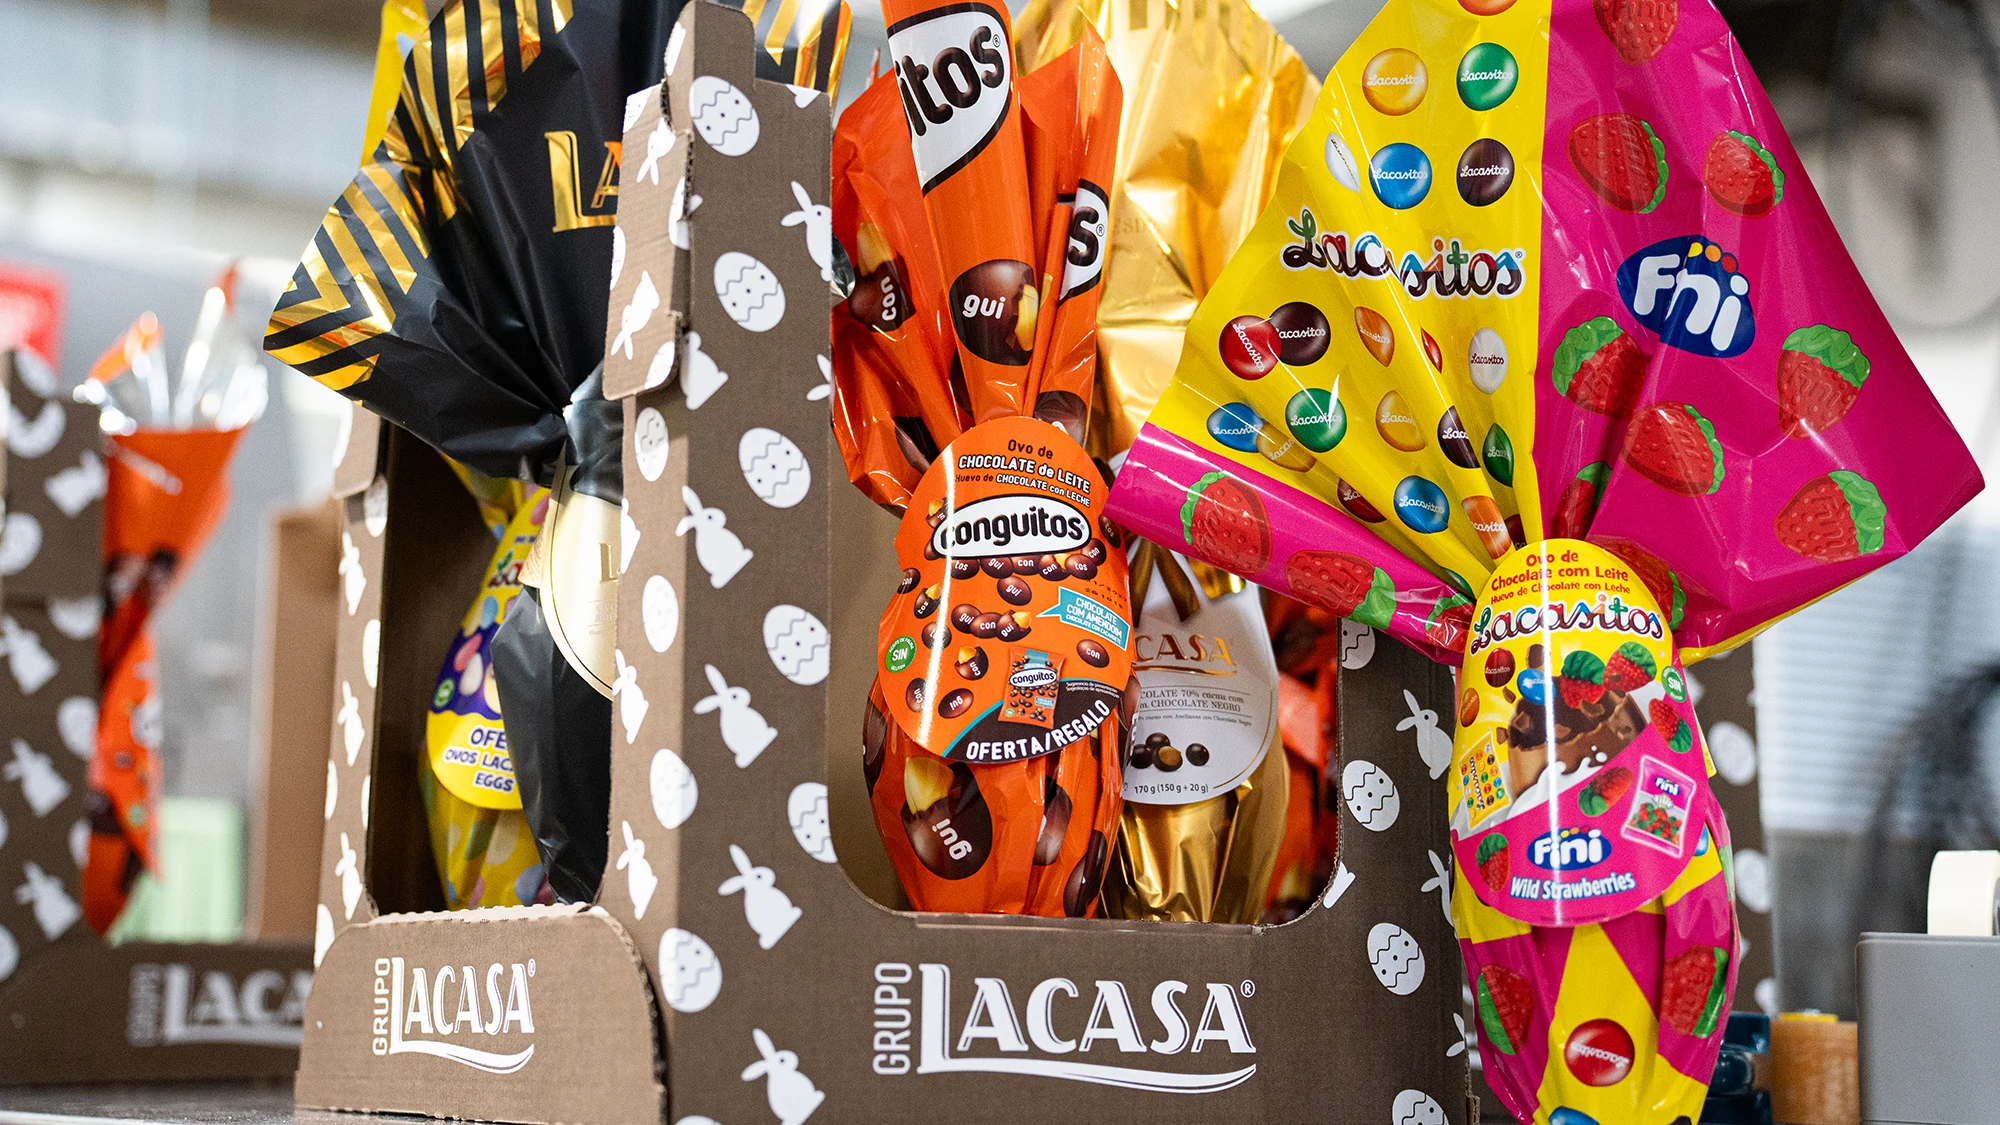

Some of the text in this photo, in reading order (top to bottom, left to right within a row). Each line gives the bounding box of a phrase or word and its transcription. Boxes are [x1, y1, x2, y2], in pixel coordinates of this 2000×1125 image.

[1372, 168, 1428, 180] Lacasitos
[1460, 164, 1510, 177] Lacasitos
[881, 276, 896, 322] con
[962, 294, 1006, 320] gui
[1232, 322, 1266, 372] Lacasitos
[1470, 353, 1504, 365] Lacasitos
[1008, 440, 1054, 460] Ovo de
[958, 454, 1091, 494] CHOCOLATE de LEITE
[955, 473, 1091, 508] Huevo de CHOCOLATE con LECHE
[940, 505, 1083, 550] conguitos
[1087, 547, 1101, 560] con
[1526, 549, 1579, 567] Ovo de
[954, 560, 969, 571] tos
[989, 558, 1005, 571] gui
[1018, 558, 1034, 568] con
[1042, 562, 1058, 576] con
[1075, 560, 1088, 572] tos
[1491, 566, 1629, 591] Chocolate com Leite
[1005, 583, 1021, 597] gui
[1490, 581, 1631, 605] Huevo de Chocolate con Leche
[918, 600, 929, 615] tos
[1076, 597, 1118, 626] CHOCOLATE
[958, 612, 973, 626] gui
[980, 620, 996, 631] con
[1066, 604, 1123, 640] COM AMENDOIM
[1470, 594, 1664, 655] Lacasitos
[1000, 623, 1014, 638] gui
[892, 647, 909, 662] SIN
[1085, 647, 1101, 661] con
[970, 660, 981, 677] con
[1012, 671, 1055, 685] conguitos
[1668, 676, 1682, 693] SIN
[949, 696, 964, 711] gui
[1181, 689, 1200, 698] 70%
[1202, 691, 1227, 701] cacau
[1228, 696, 1244, 704] com
[1151, 699, 1208, 709] CHOCOLATE
[1211, 701, 1241, 713] NEGRO
[965, 699, 1111, 761] OFERTA/REGALO
[482, 754, 513, 772] LAC
[475, 772, 514, 792] EGGS
[1134, 785, 1149, 794] 170
[1150, 787, 1156, 795] g
[1157, 784, 1175, 793] (150
[1176, 785, 1181, 794] g
[1190, 784, 1201, 792] 20
[1201, 784, 1209, 794] g)
[1654, 777, 1680, 796] Fini
[932, 818, 973, 861] gui
[1534, 829, 1603, 867] Fini
[1510, 871, 1636, 900] Wild Strawberries
[372, 957, 391, 1056] GRUPO
[872, 961, 912, 1076] GRUPO
